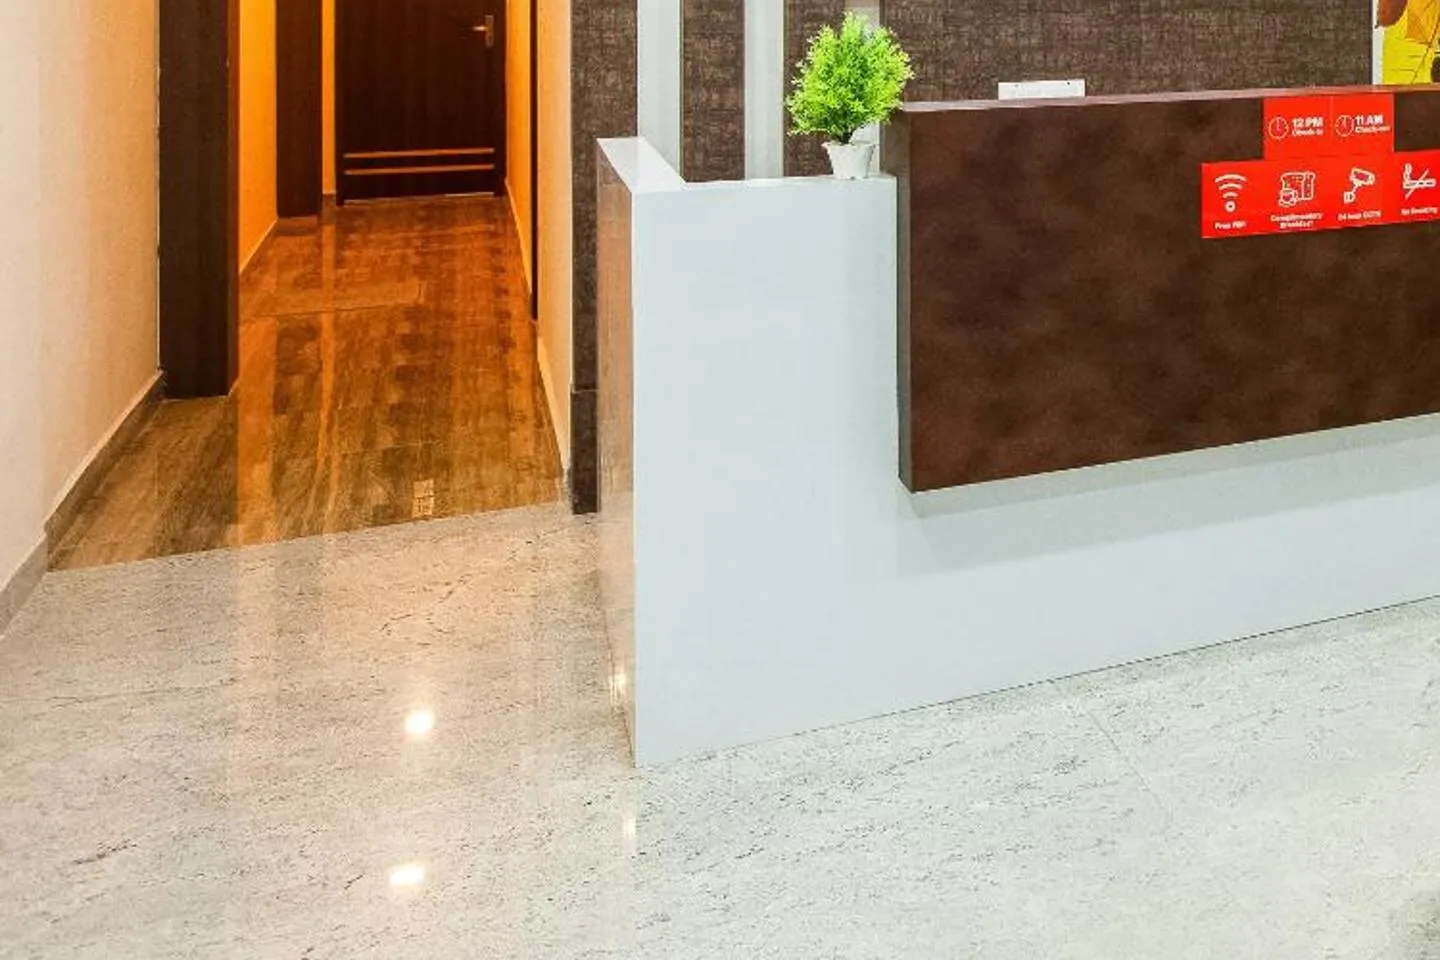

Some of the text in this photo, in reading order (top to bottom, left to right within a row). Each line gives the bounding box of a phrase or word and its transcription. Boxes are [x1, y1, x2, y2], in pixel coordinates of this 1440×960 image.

[1292, 116, 1324, 128] 12 PM
[1355, 114, 1384, 125] 11 AM
